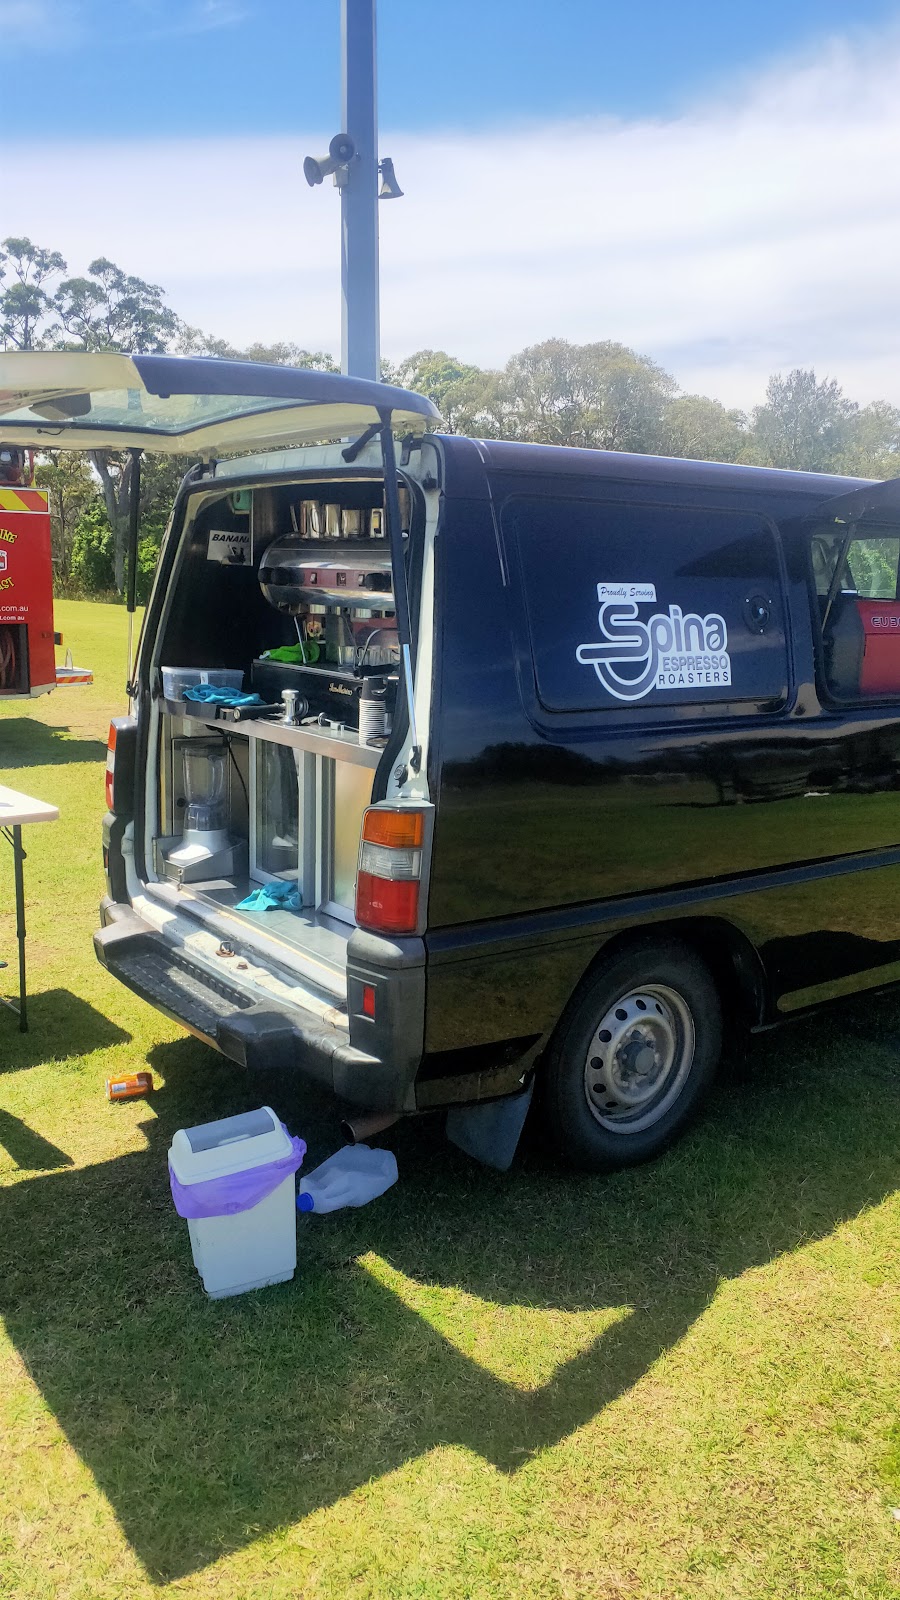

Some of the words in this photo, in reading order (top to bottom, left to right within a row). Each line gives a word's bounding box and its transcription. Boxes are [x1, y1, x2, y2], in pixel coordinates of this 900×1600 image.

[600, 587, 627, 598] Proudly
[630, 587, 654, 599] Serving
[577, 602, 727, 700] Spina
[662, 655, 728, 671] ESPRESSO
[658, 671, 729, 685] ROASTERS
